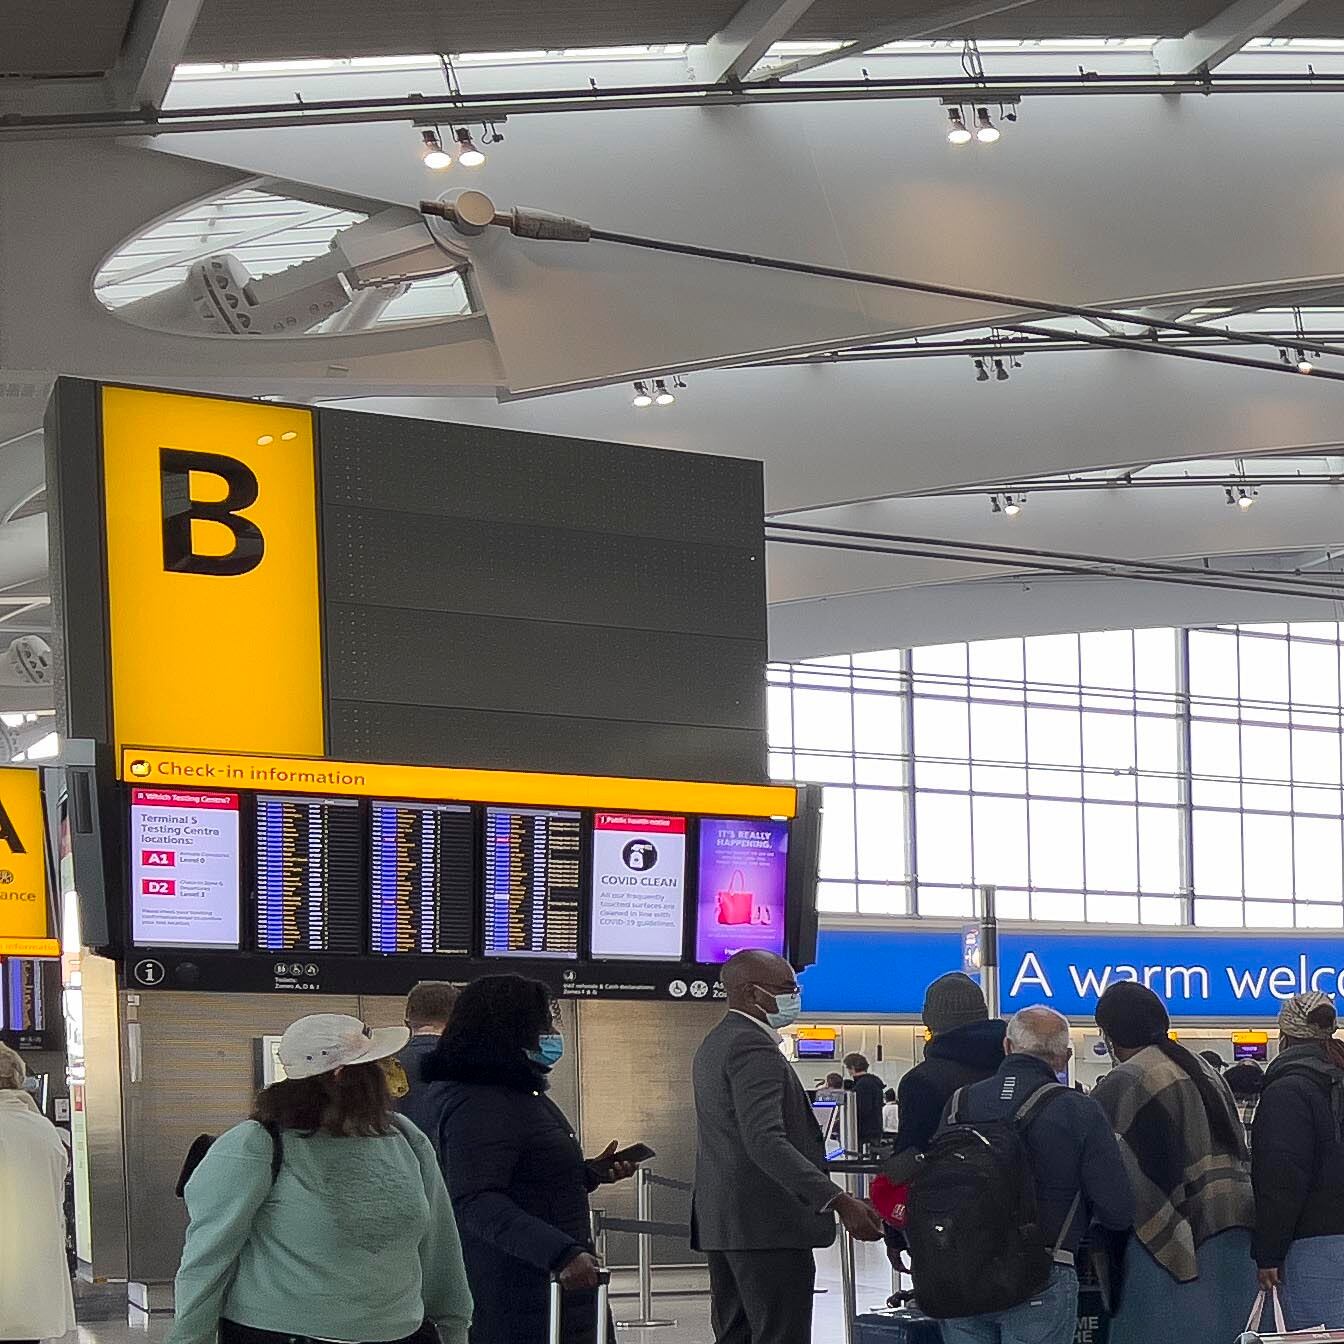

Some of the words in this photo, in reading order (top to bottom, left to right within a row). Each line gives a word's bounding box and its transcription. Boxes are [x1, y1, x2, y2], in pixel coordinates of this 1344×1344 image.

[159, 447, 265, 576] B
[157, 761, 244, 779] Check-in
[250, 768, 366, 786] information
[145, 793, 171, 801] Which
[172, 794, 200, 803] Testing
[200, 796, 230, 804] Centre?
[141, 814, 188, 824] Terminal
[191, 816, 198, 824] 5
[141, 824, 181, 835] Testing
[184, 826, 219, 836] Centre
[738, 831, 771, 841] REALLY
[148, 853, 169, 864] A1
[148, 881, 169, 893] D2
[601, 875, 638, 885] COVID
[640, 877, 677, 887] CLEAN
[0, 891, 37, 902] ance
[1009, 952, 1053, 997] A
[1068, 964, 1208, 999] warm
[1077, 1316, 1099, 1330] ME
[1073, 1330, 1093, 1343] HE
